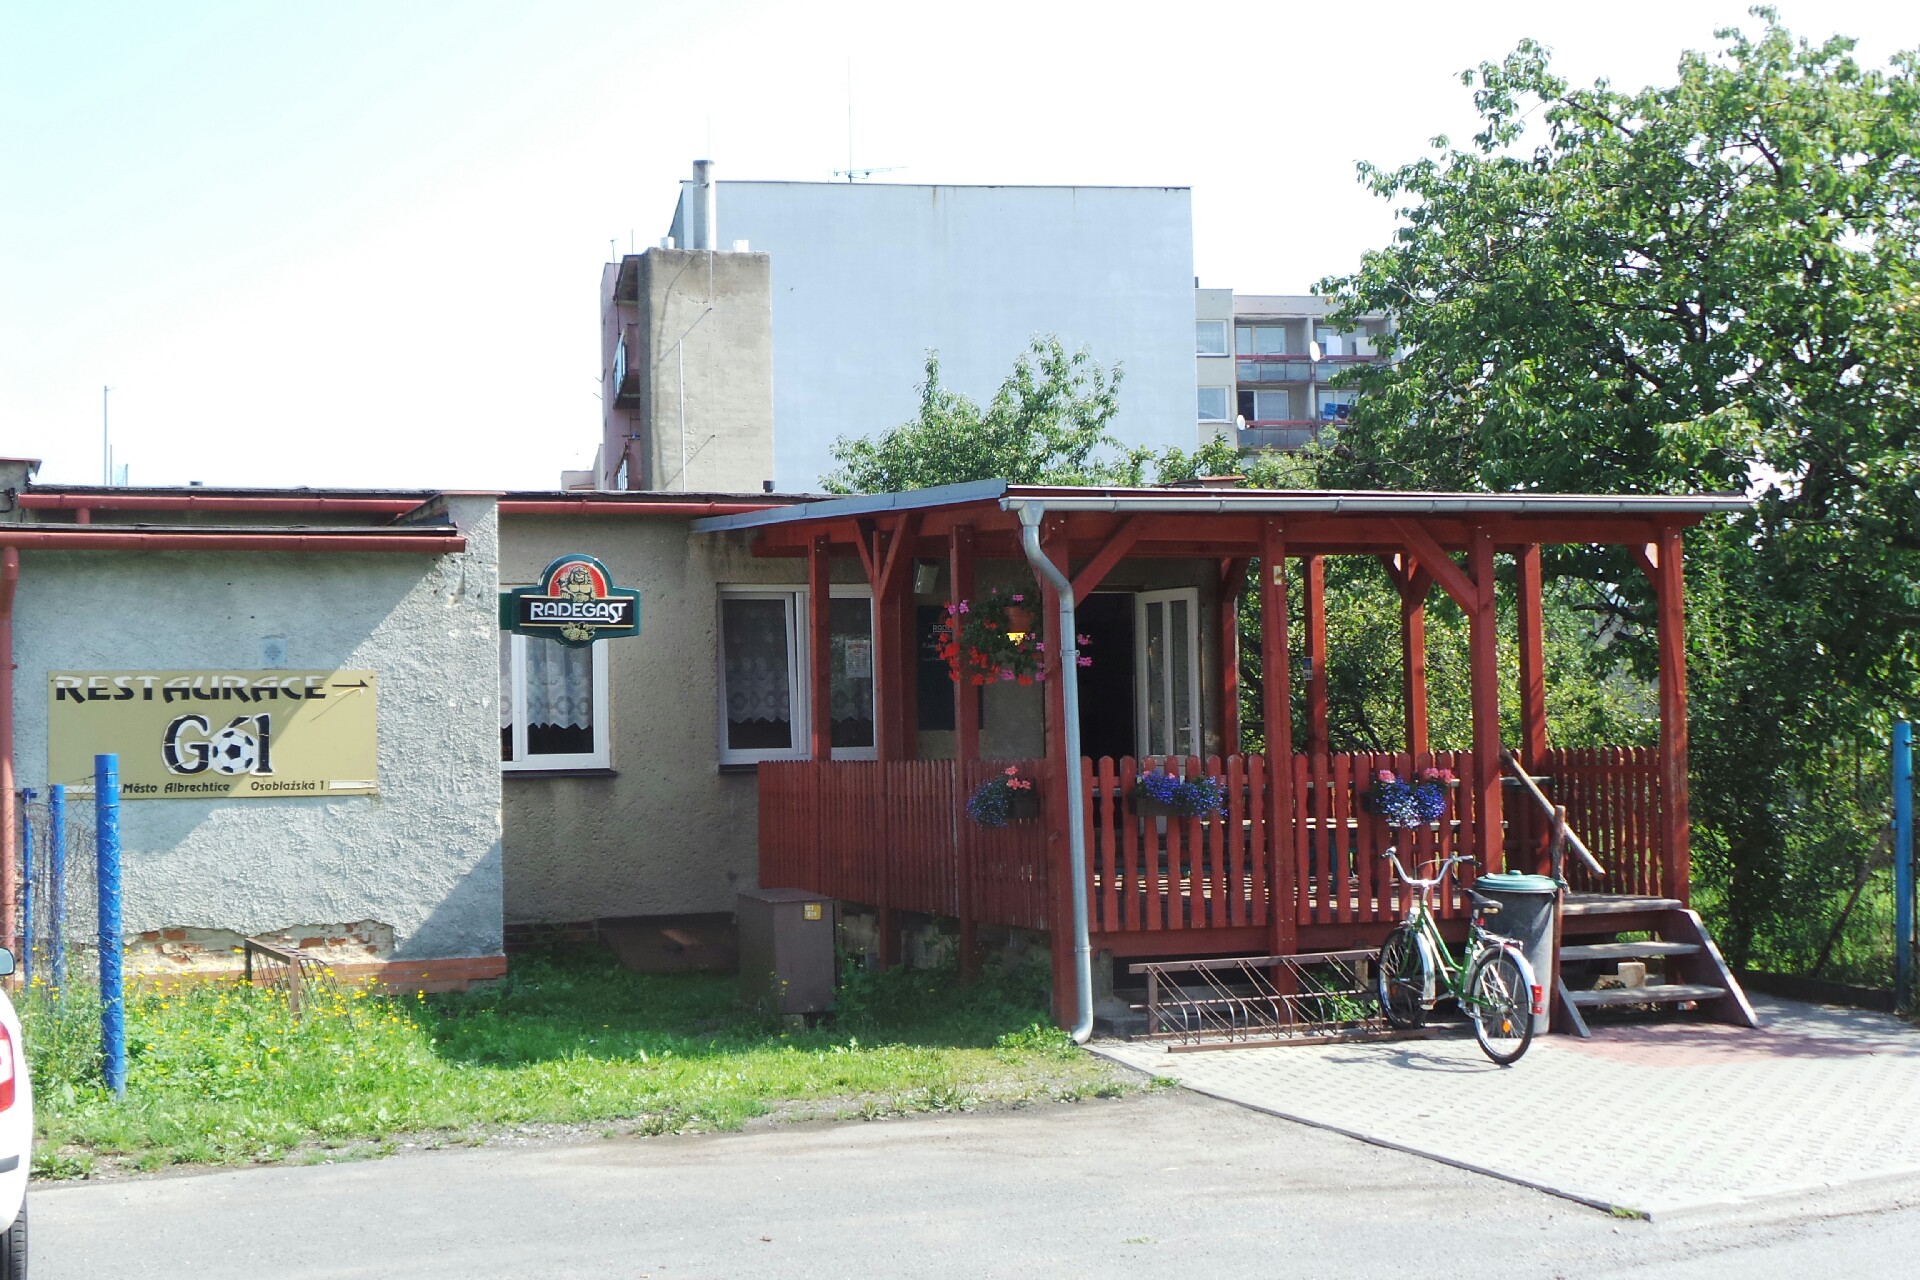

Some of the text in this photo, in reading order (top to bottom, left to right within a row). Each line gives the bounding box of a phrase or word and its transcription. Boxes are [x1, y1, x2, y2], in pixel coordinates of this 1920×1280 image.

[530, 602, 627, 623] RADEGAST
[55, 674, 327, 704] RESTAURACE
[122, 779, 325, 794] Město Albrechtice Osoblažská 1
